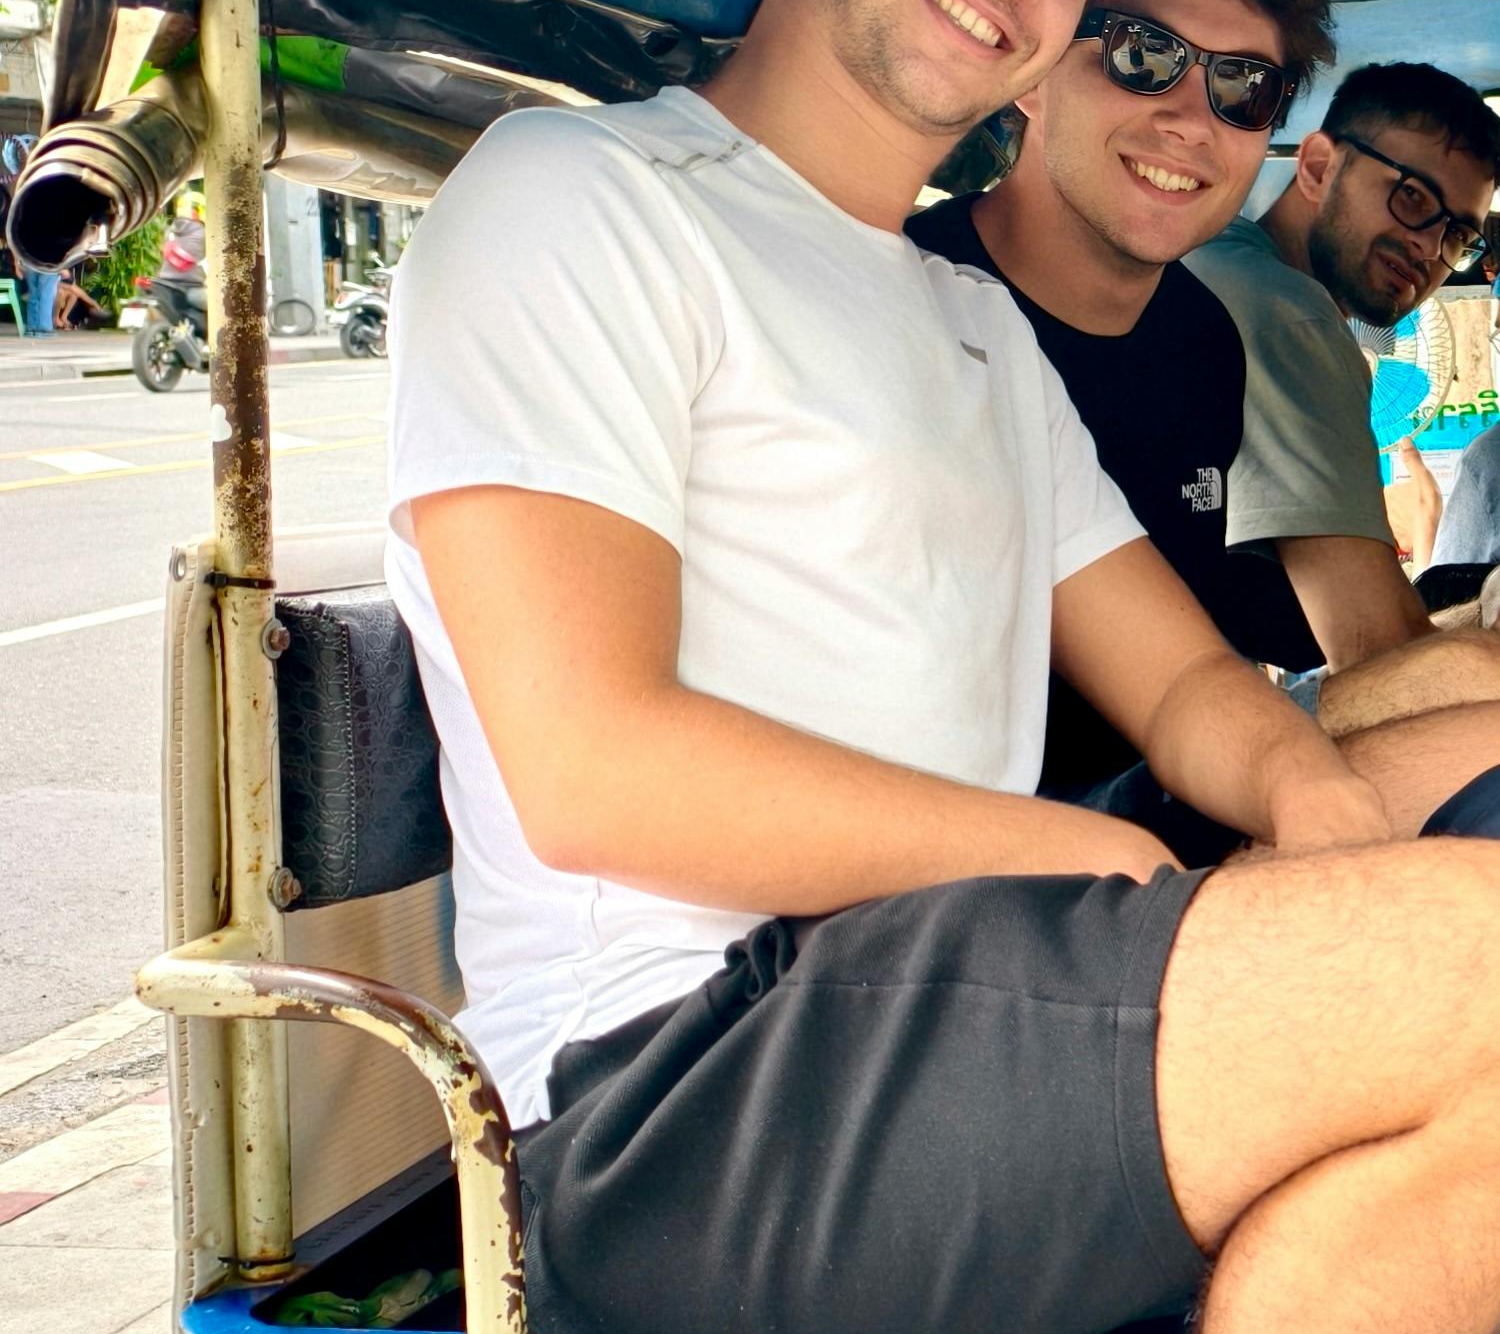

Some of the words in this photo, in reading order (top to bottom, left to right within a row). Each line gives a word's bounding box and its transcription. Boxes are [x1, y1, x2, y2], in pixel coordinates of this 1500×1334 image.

[1196, 467, 1213, 483] THE
[1181, 482, 1211, 499] NORTH
[1191, 496, 1214, 513] FACE
